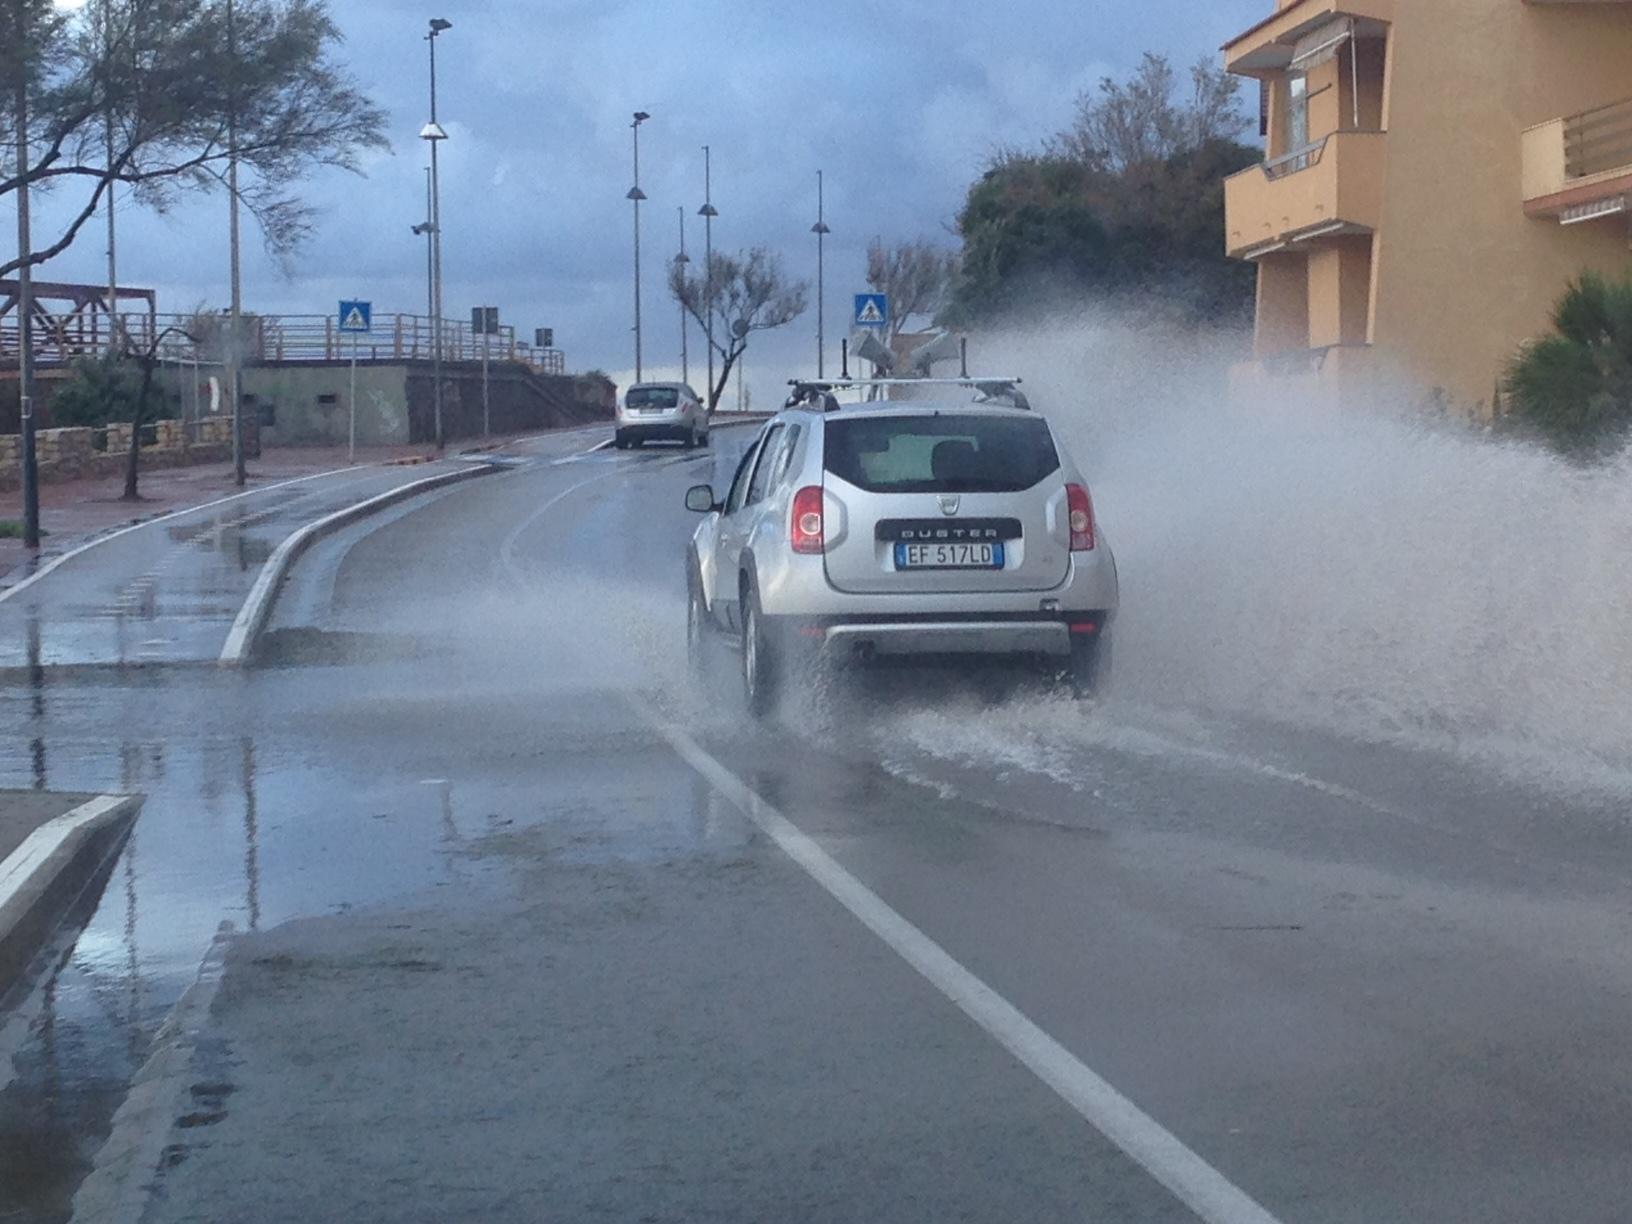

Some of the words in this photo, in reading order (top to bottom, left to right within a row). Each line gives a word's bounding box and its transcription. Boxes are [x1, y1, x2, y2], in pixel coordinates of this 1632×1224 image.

[901, 529, 997, 538] DUSTER
[908, 546, 929, 564] EF
[937, 546, 991, 563] 517LD
